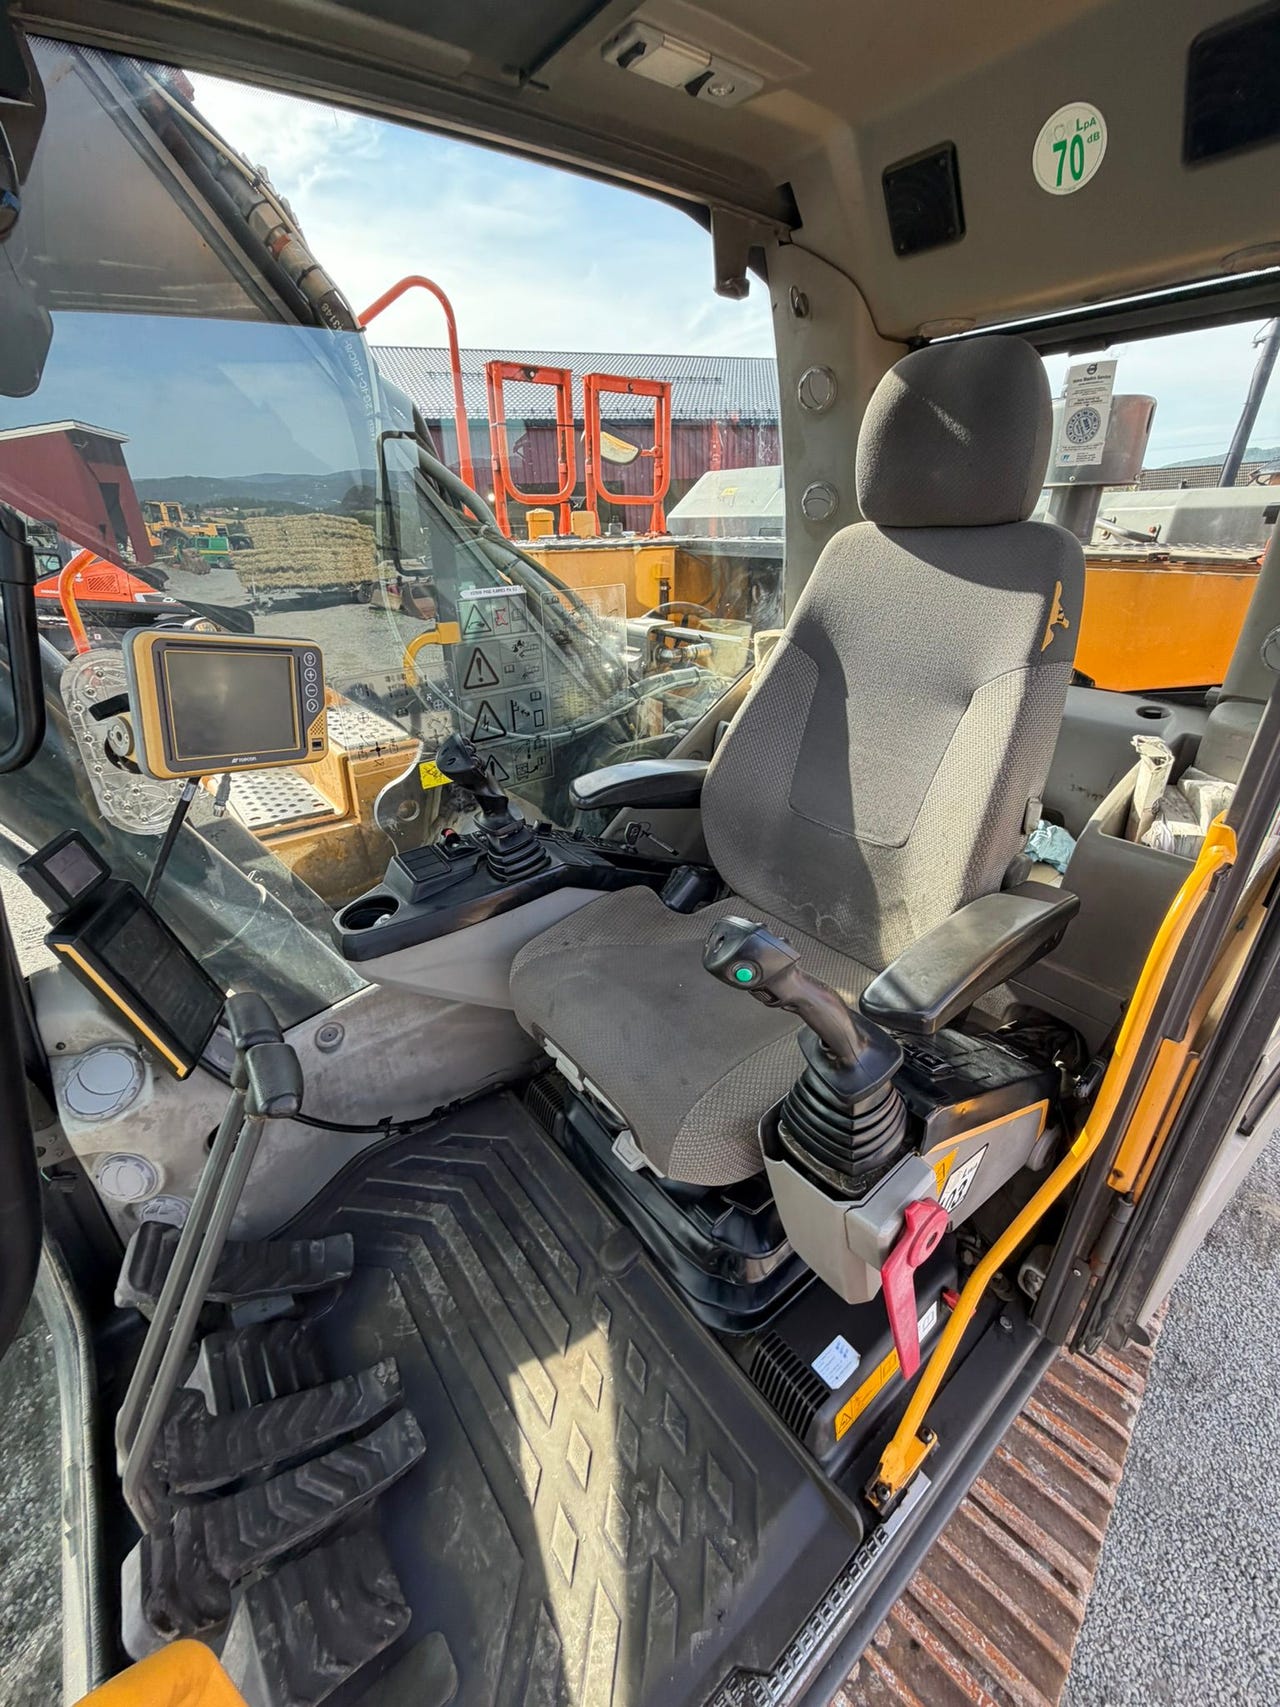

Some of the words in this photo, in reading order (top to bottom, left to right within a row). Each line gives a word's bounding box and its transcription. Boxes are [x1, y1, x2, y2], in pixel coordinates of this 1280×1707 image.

[1076, 117, 1097, 133] LpA
[1086, 132, 1100, 144] dB
[1052, 133, 1085, 187] 70
